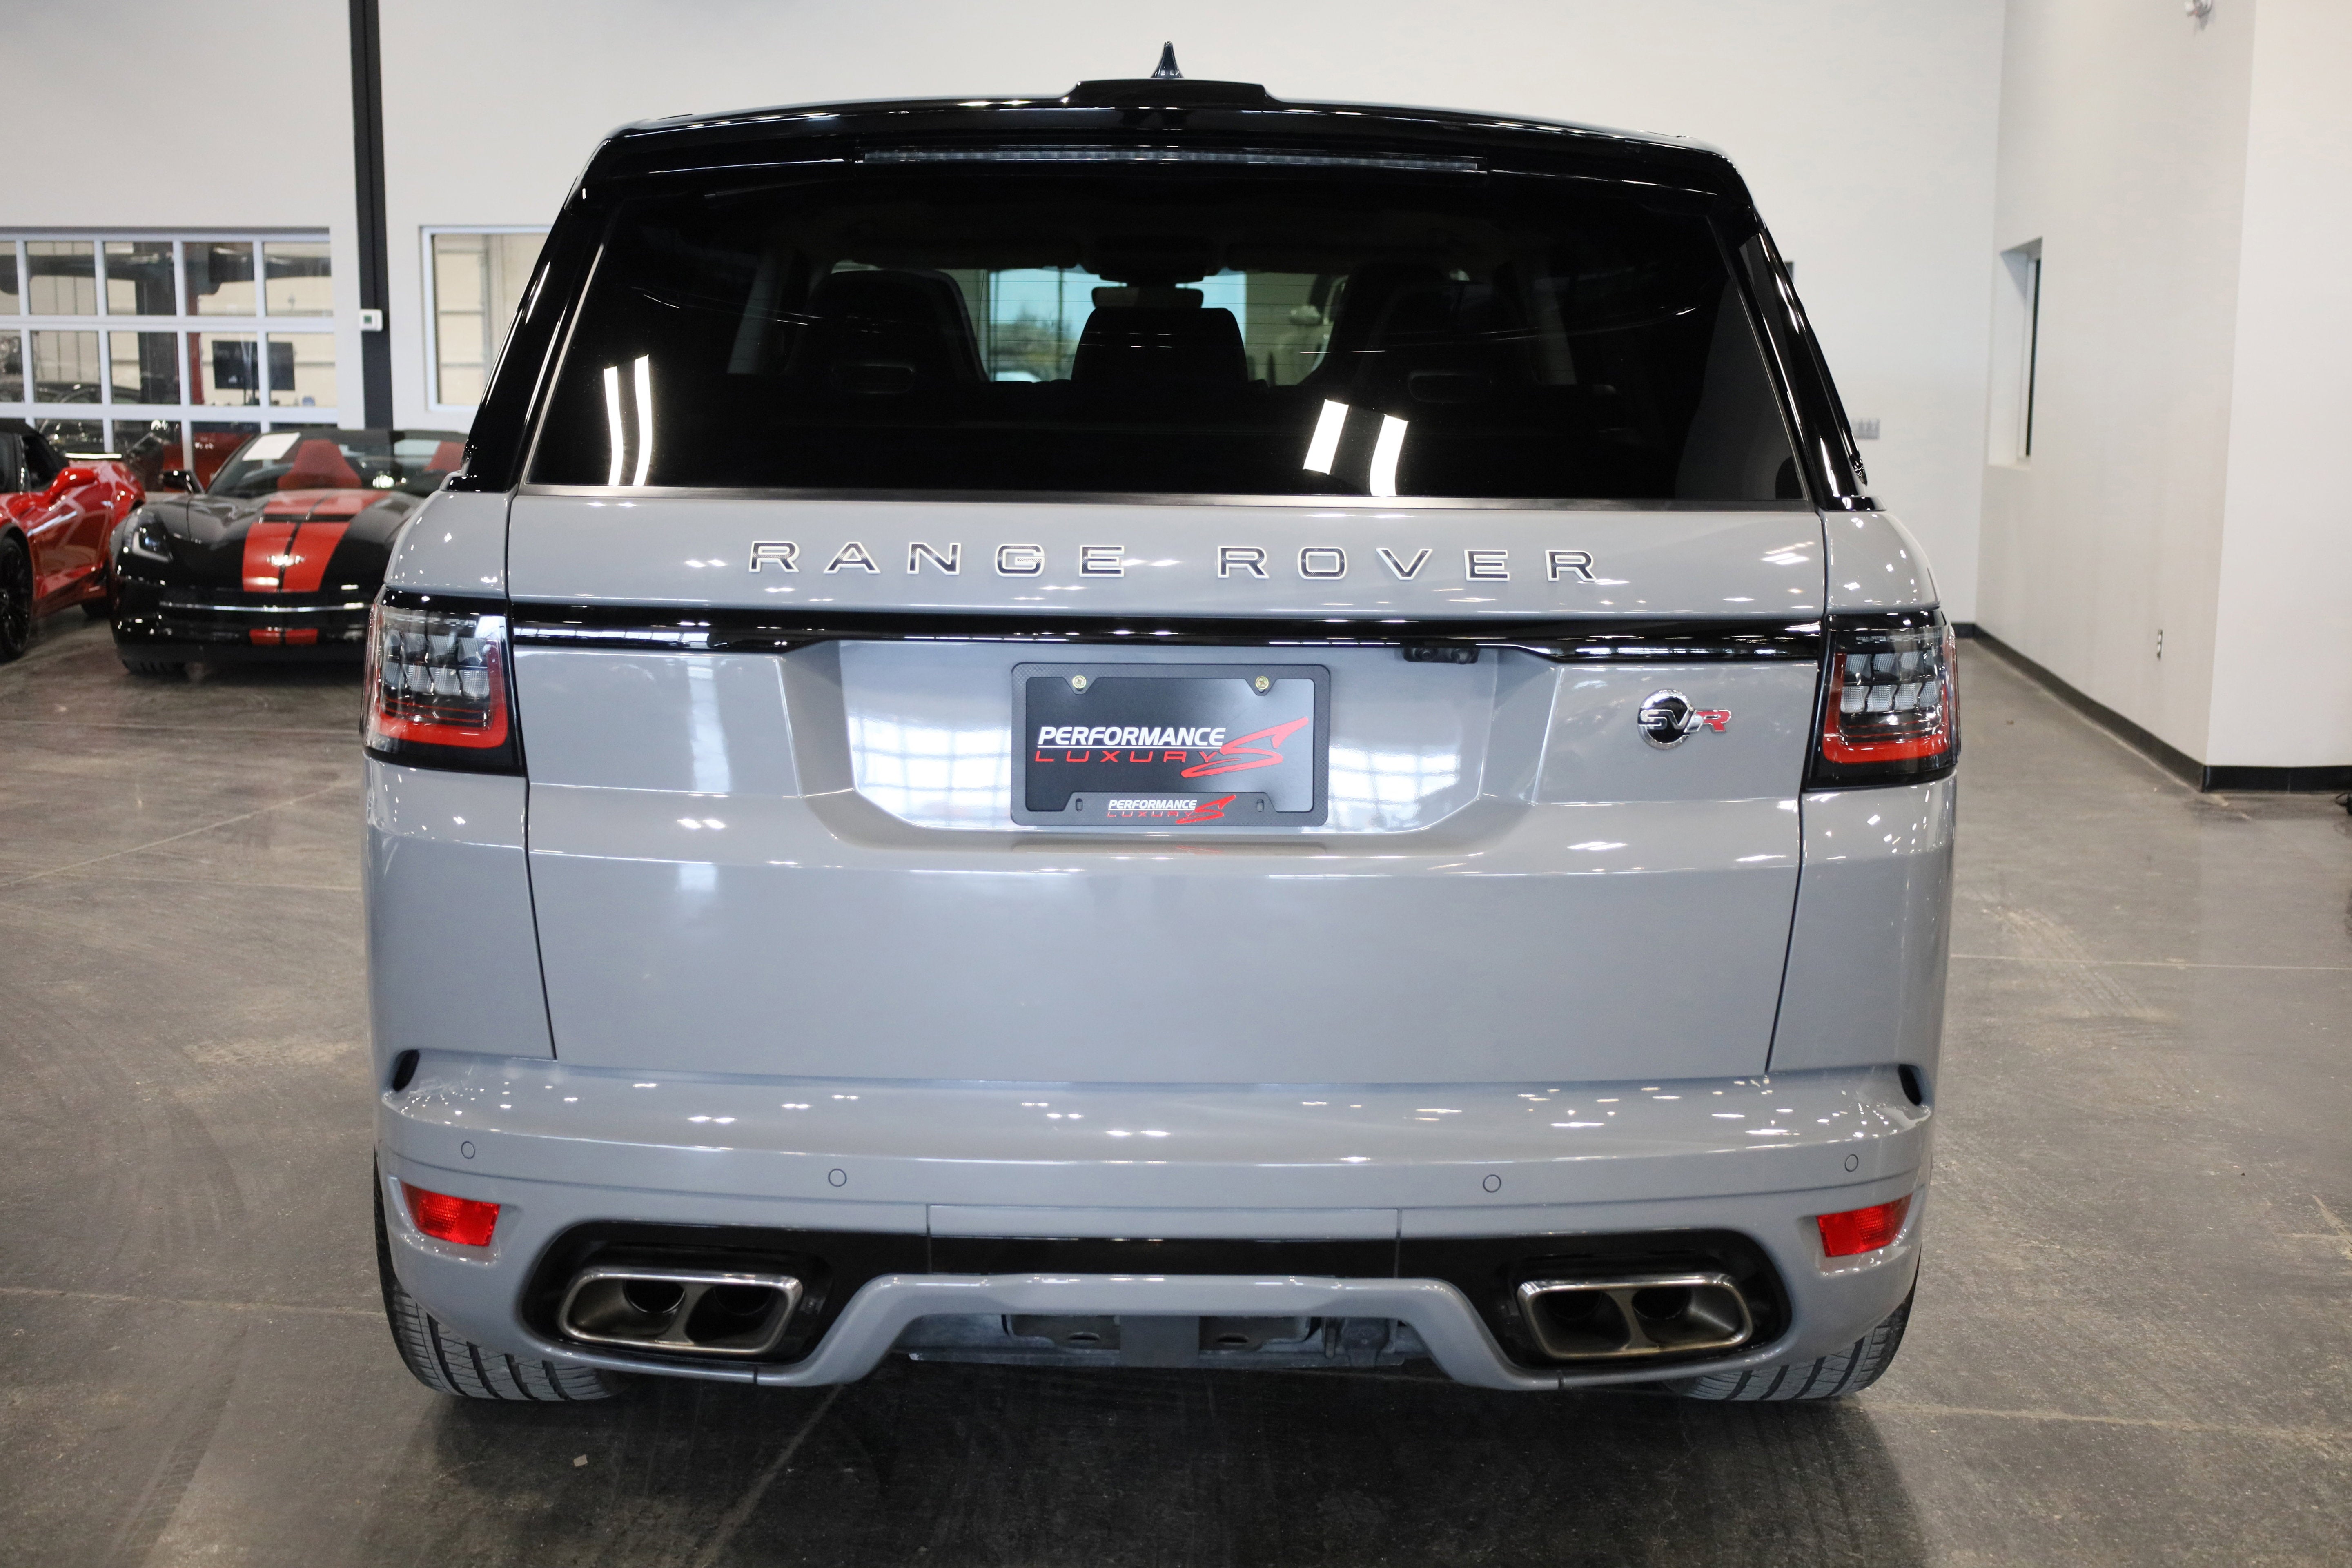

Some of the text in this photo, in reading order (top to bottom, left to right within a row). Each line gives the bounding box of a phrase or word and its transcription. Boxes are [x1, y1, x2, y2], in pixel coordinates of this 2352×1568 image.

[749, 541, 1597, 581] RANGE ROVER
[1639, 709, 1731, 733] SVR
[1038, 726, 1226, 746] PERFORMANCE
[1034, 751, 1218, 763] LUXURY
[1108, 799, 1197, 809] PERFORMANCE
